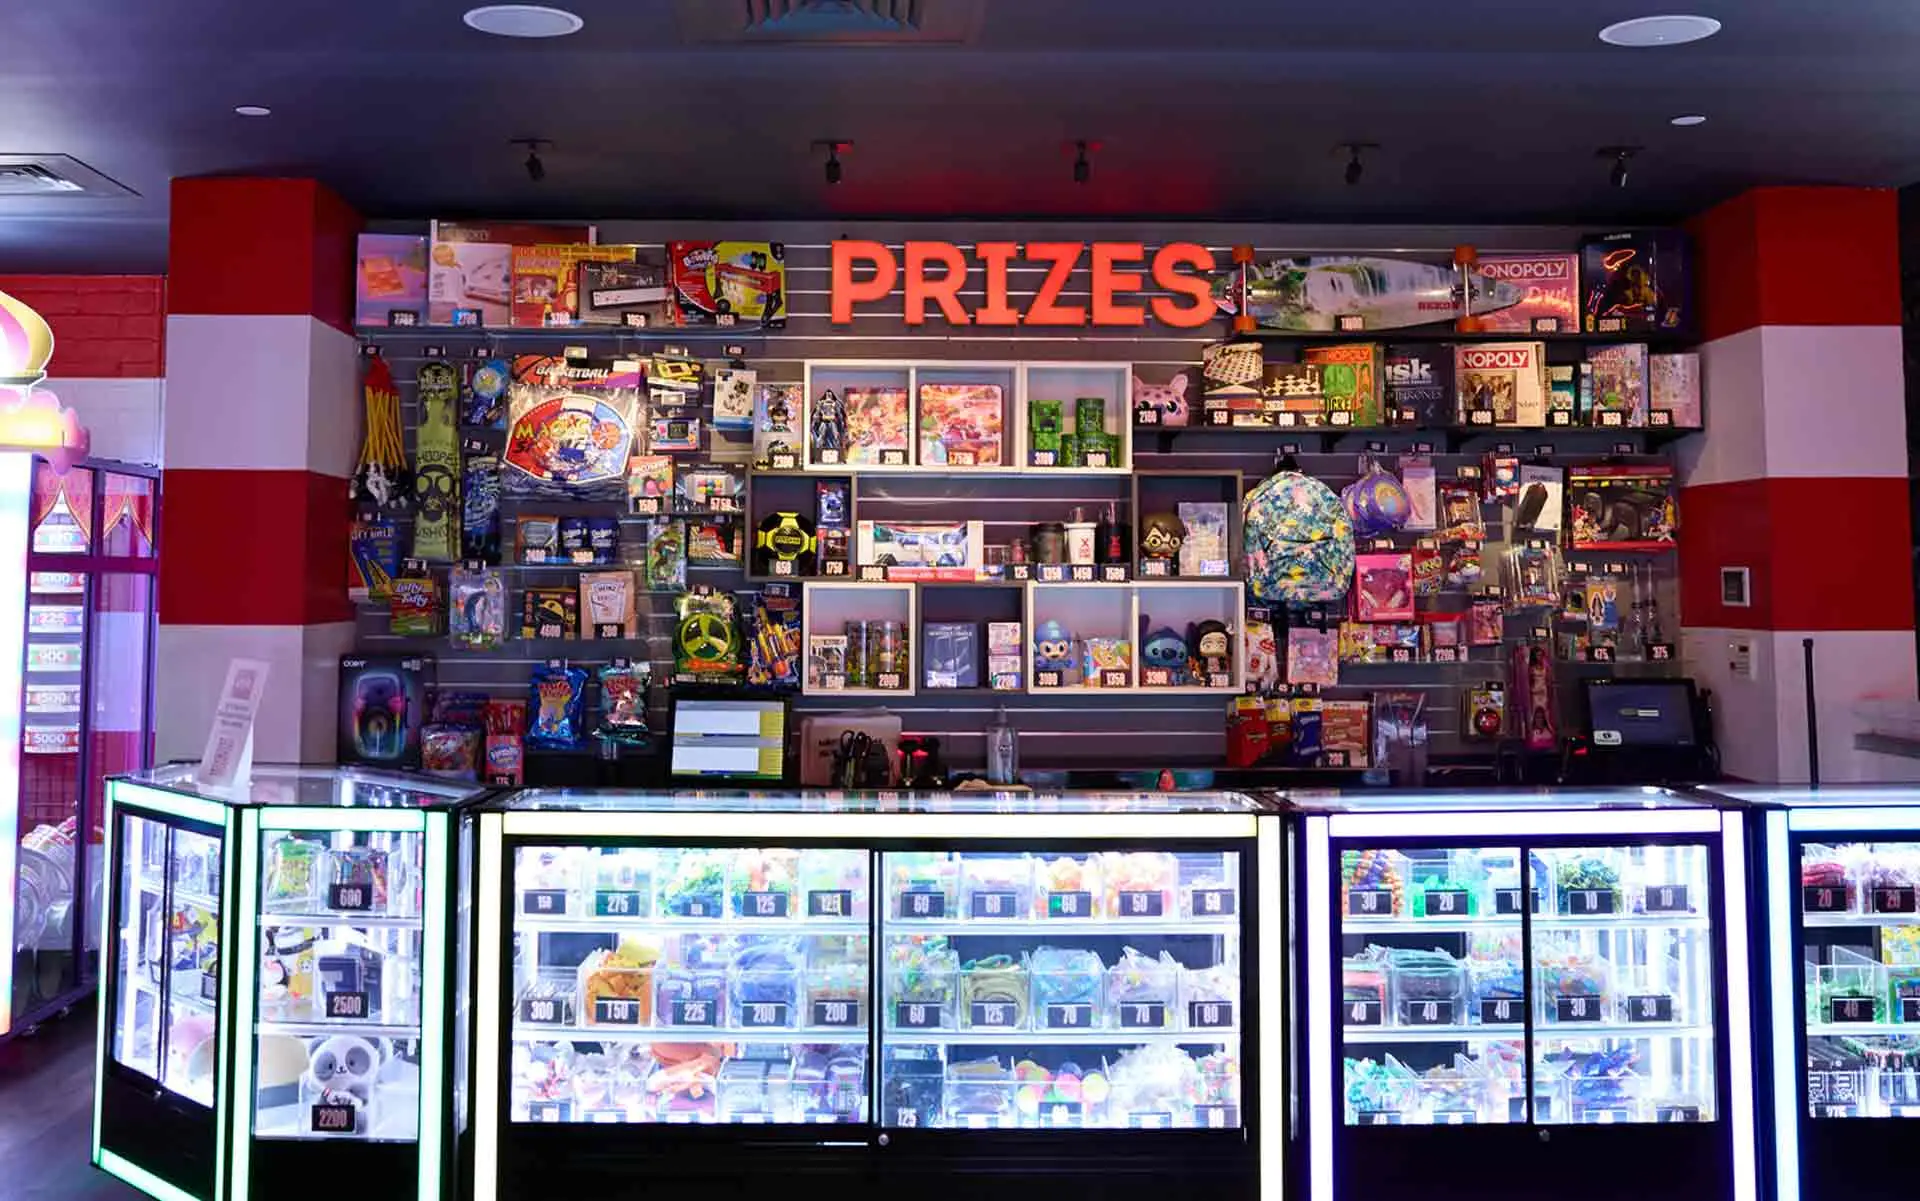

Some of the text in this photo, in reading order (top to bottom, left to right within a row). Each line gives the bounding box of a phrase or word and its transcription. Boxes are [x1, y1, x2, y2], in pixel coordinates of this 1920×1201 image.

[831, 240, 1217, 327] PRIZES
[1385, 357, 1432, 381] isk
[1464, 351, 1528, 368] NOPOLY
[33, 734, 66, 745] 5000
[607, 896, 629, 913] 275
[756, 895, 776, 914] 125
[1361, 892, 1377, 910] 30
[1439, 892, 1454, 911] 20
[1584, 890, 1599, 910] 10
[1659, 887, 1674, 907] 10
[1817, 888, 1832, 908] 20
[333, 995, 361, 1015] 2500
[531, 1001, 554, 1020] 300
[607, 1002, 629, 1020] 150
[683, 1003, 706, 1022] 225
[753, 1005, 776, 1023] 200
[825, 1004, 848, 1022] 200
[1351, 1001, 1367, 1022] 40
[1422, 1000, 1438, 1021] 40
[1494, 1000, 1510, 1019] 40
[1570, 997, 1586, 1017] 30
[1641, 998, 1657, 1017] 30
[1063, 1006, 1078, 1024] 70
[1135, 1006, 1150, 1024] 70
[318, 1108, 347, 1128] 2200
[897, 1107, 917, 1127] 125
